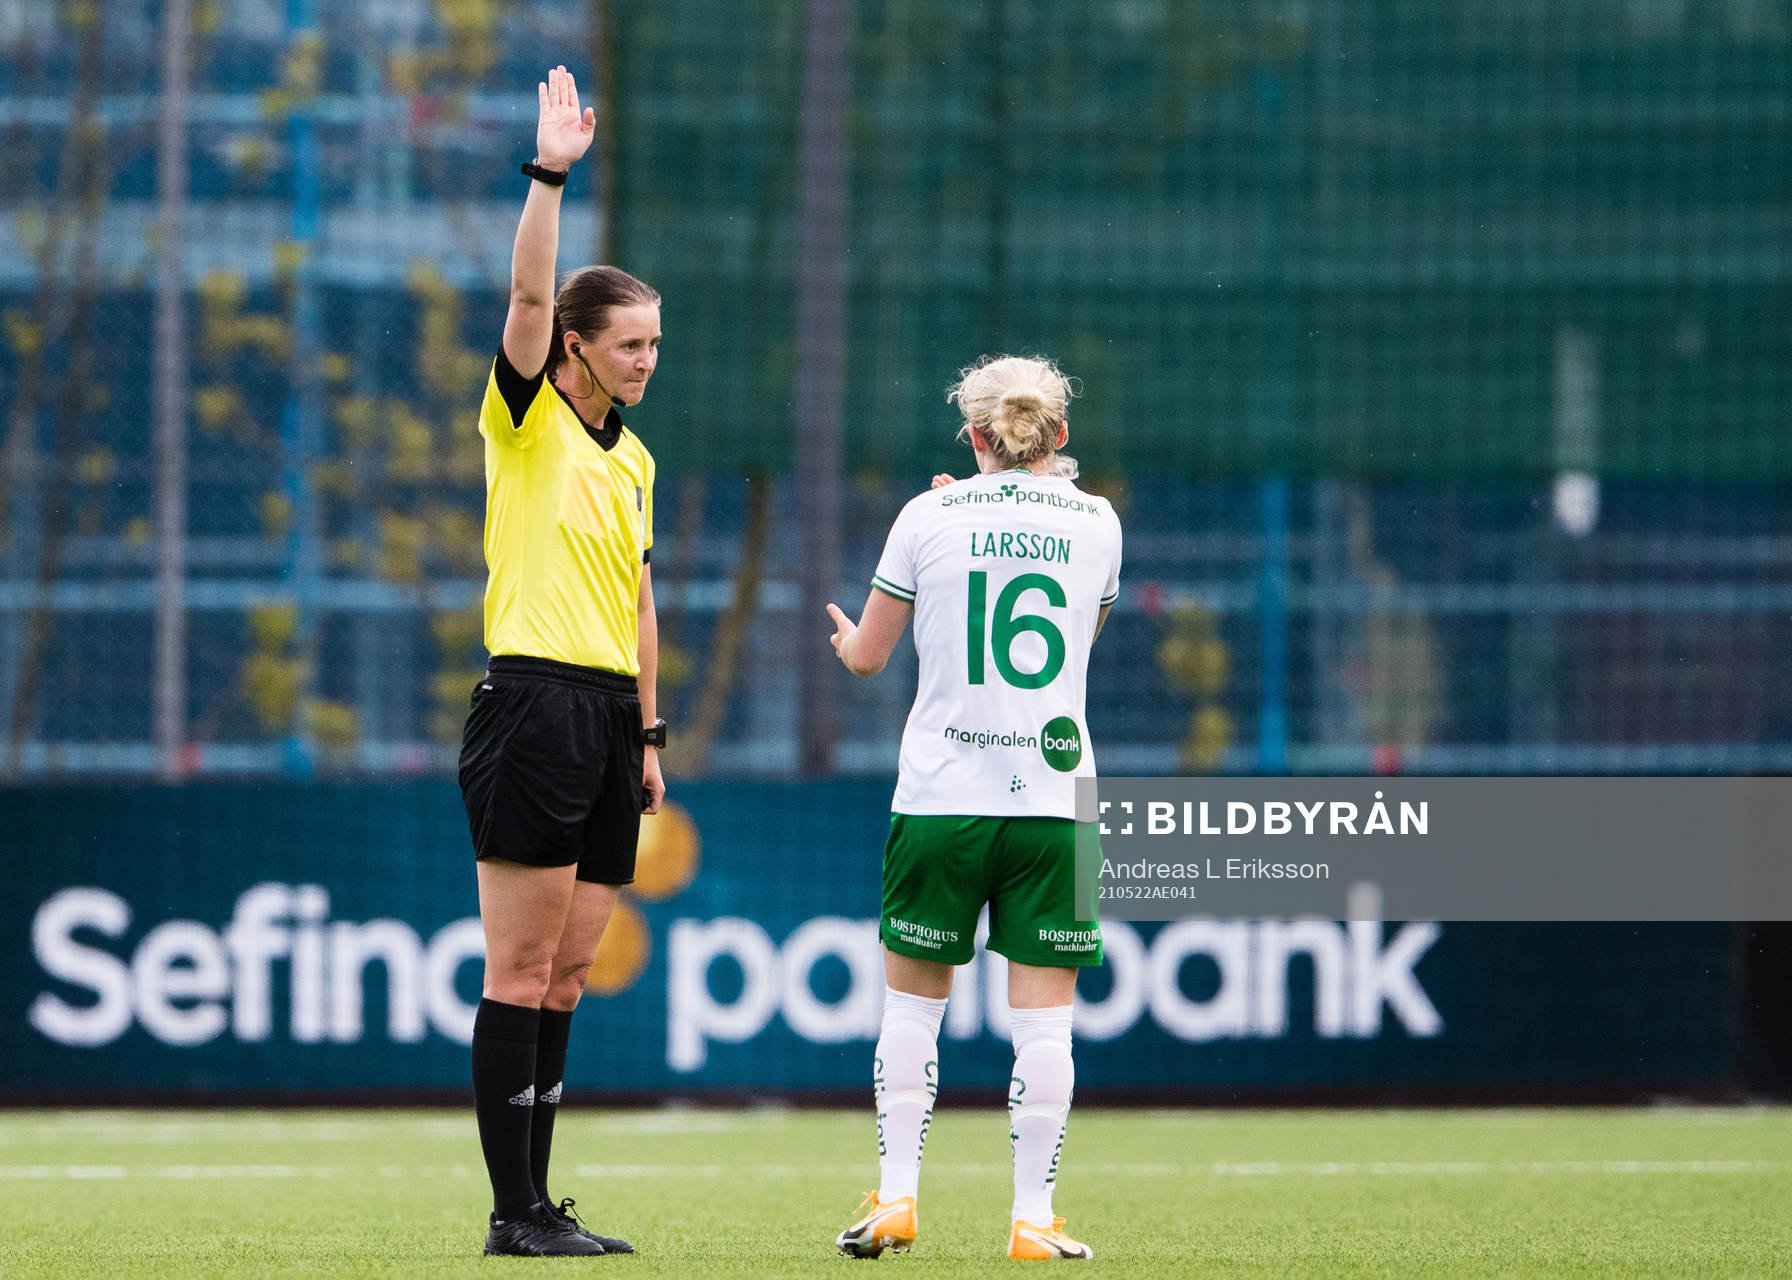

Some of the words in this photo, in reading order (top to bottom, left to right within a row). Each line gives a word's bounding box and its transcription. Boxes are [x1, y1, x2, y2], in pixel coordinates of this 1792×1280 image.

[941, 490, 1004, 507] Sefina
[1015, 490, 1101, 517] pantbank
[971, 532, 1071, 565] LARSSON
[967, 570, 1067, 690] 16
[944, 726, 1037, 749] marginalen
[1044, 731, 1080, 753] bank
[890, 917, 959, 942] BOSPHORUS
